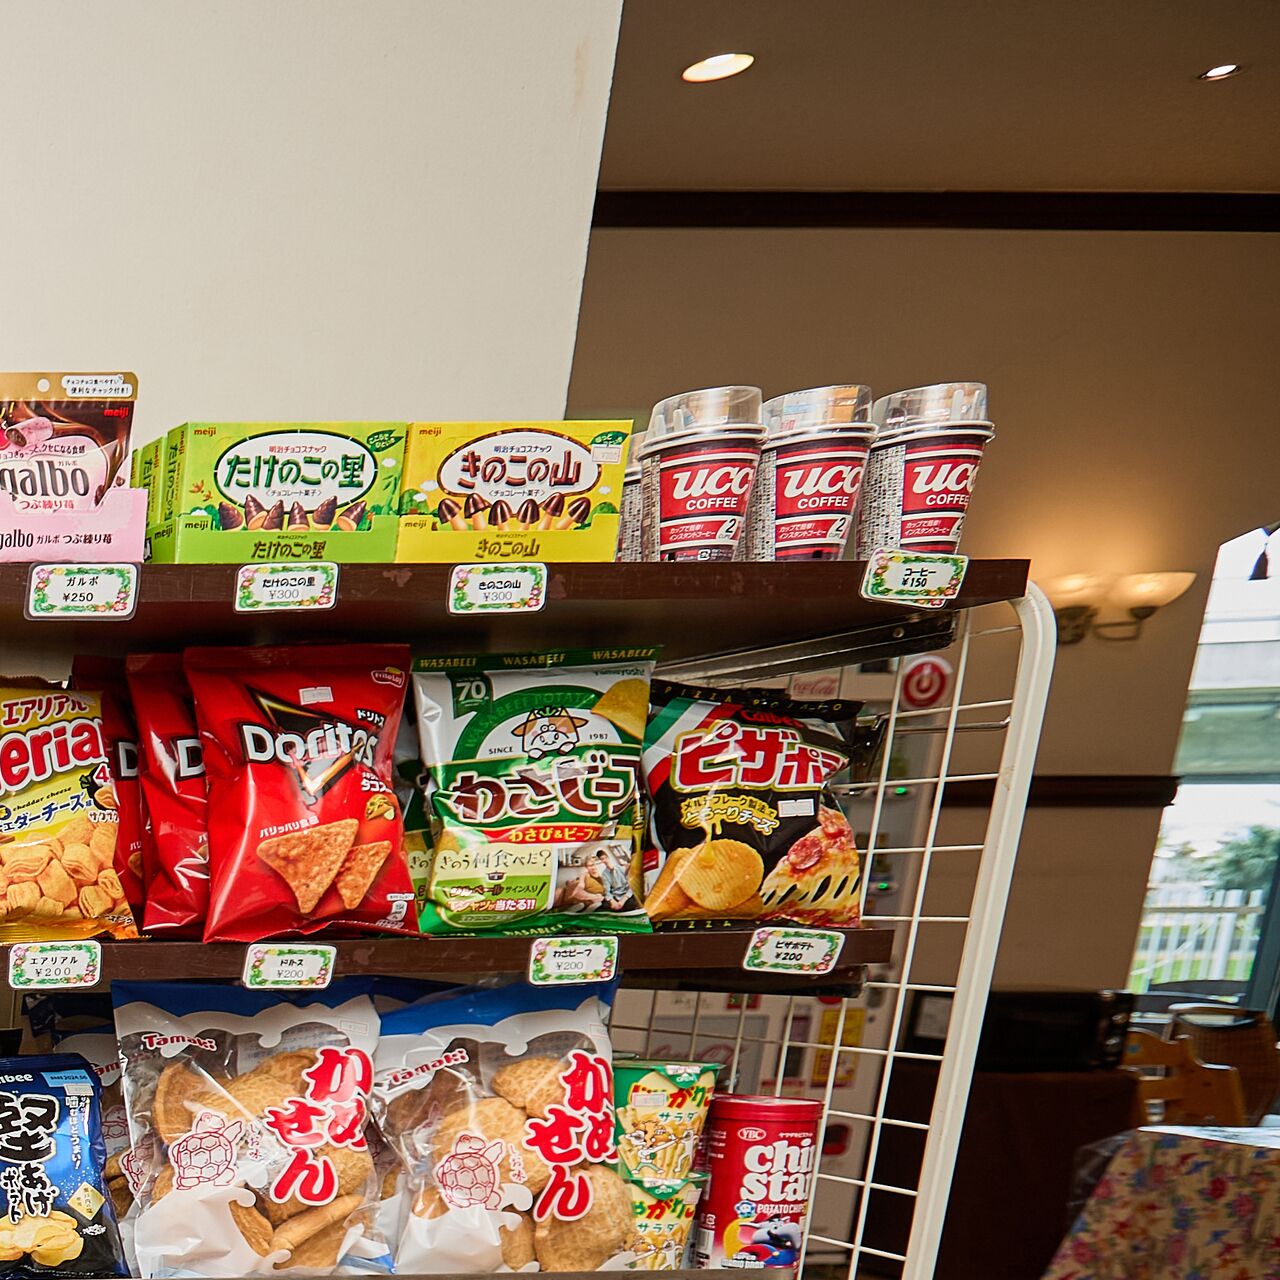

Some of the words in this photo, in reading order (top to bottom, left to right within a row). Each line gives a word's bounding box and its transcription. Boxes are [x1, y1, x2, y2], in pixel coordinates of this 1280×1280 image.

[104, 408, 128, 419] meiji
[193, 428, 216, 436] meiji
[269, 445, 326, 453] 明治チョコスナック
[494, 445, 552, 453] 明治チョコスナック
[225, 453, 365, 489] たけのこの里
[459, 451, 581, 488] きのこの山
[0, 461, 89, 496] galbo
[20, 500, 74, 509] つぶ練り苺
[686, 498, 738, 510] COFFEE
[797, 497, 848, 509] COFFEE
[185, 520, 209, 530] meiji
[37, 536, 59, 544] ガルボ
[63, 535, 112, 544] つぶ練り苺
[251, 540, 326, 559] たけのこの里
[475, 539, 539, 558] きのこの山
[904, 568, 936, 577] コーヒー
[66, 576, 99, 587] ガルボ
[263, 577, 316, 588] たけのこの里
[478, 580, 521, 590] きのこの山
[902, 577, 927, 588] ¥150
[63, 592, 93, 602] ¥250
[269, 589, 300, 600] ¥300
[483, 591, 512, 601] ¥300
[420, 658, 477, 667] WASABEEF
[504, 654, 566, 665] WASABEEF
[593, 649, 654, 660] WASABEEF
[3, 694, 88, 726] エアリアル
[357, 710, 384, 726] ドリトス
[243, 723, 377, 767] Doritos
[775, 941, 814, 951] ピザポテト
[552, 949, 592, 958] わさビーフ
[775, 951, 803, 962] ¥200
[30, 955, 78, 965] エアリアル
[35, 966, 72, 976] ¥200
[142, 1033, 216, 1052] Tamaki
[659, 1112, 695, 1122] サラダ
